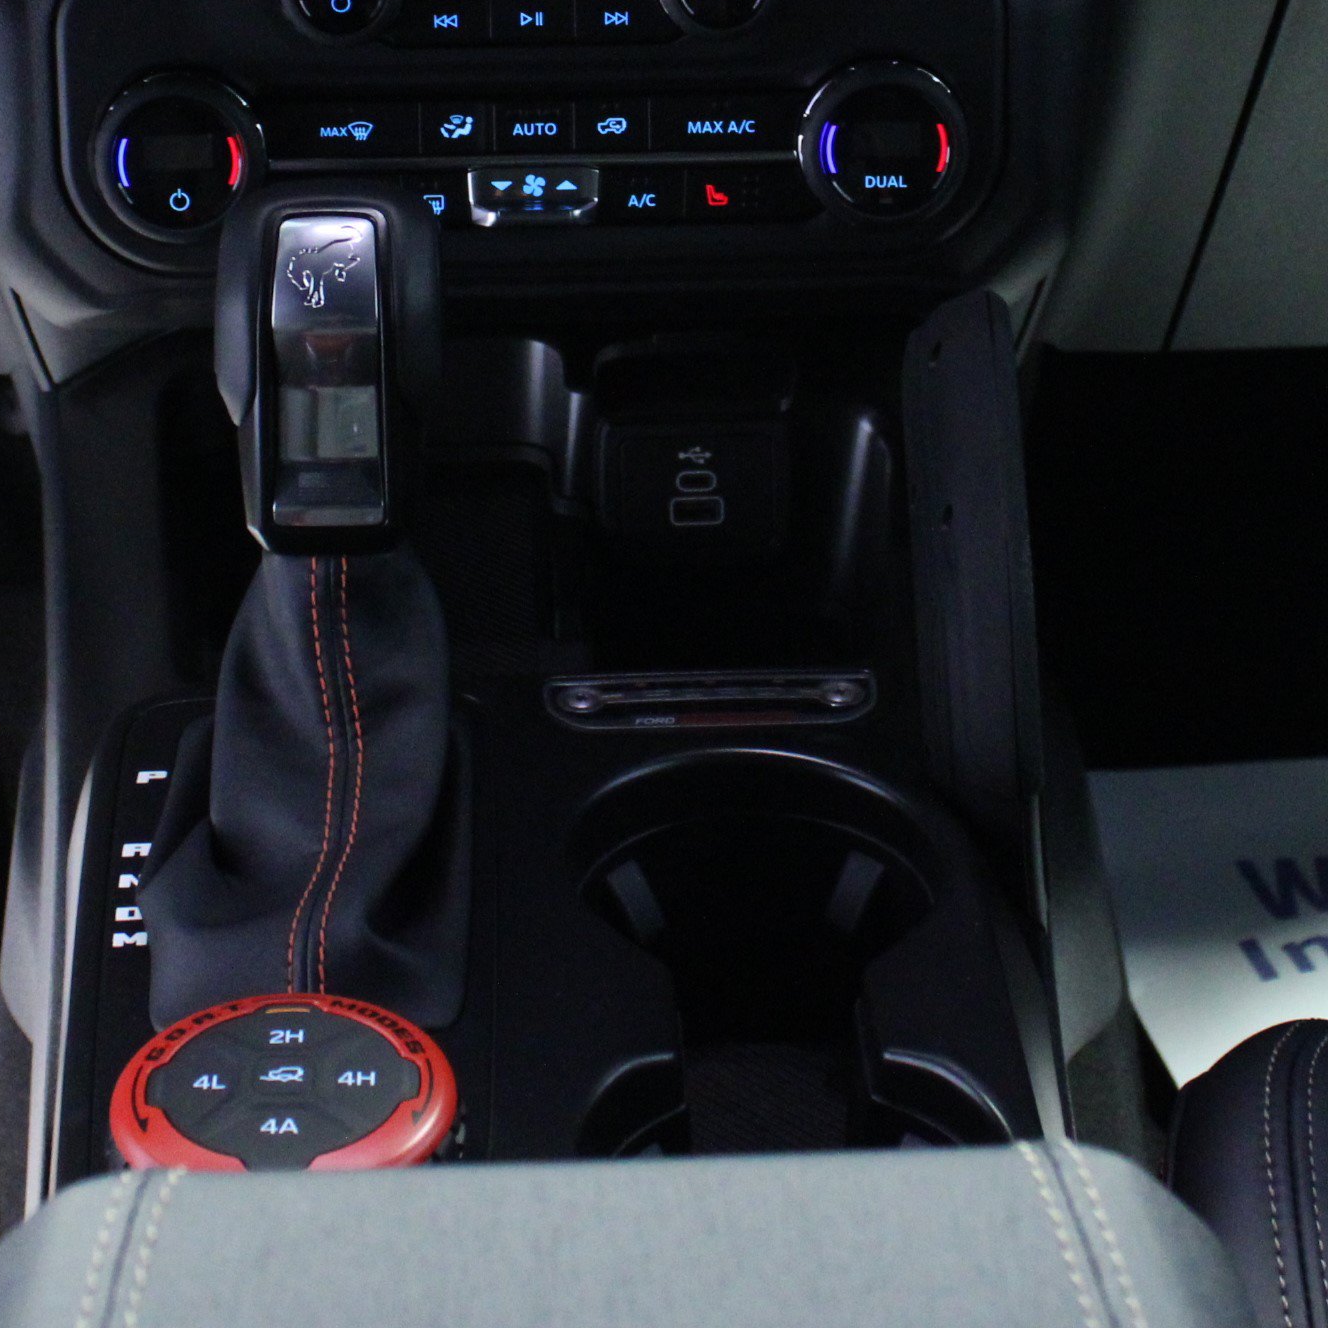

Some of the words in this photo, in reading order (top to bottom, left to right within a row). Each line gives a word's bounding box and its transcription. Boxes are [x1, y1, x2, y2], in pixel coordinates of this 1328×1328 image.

[319, 126, 348, 138] MAX
[512, 122, 557, 136] AUTO
[687, 120, 724, 134] MAX
[727, 119, 756, 134] A/C
[864, 175, 908, 189] DUAL
[628, 194, 656, 208] A/C
[136, 770, 168, 784] P
[269, 1029, 304, 1044] 2H
[192, 1075, 226, 1090] 4L
[337, 1071, 376, 1086] 4H
[259, 1118, 299, 1134] 4A
